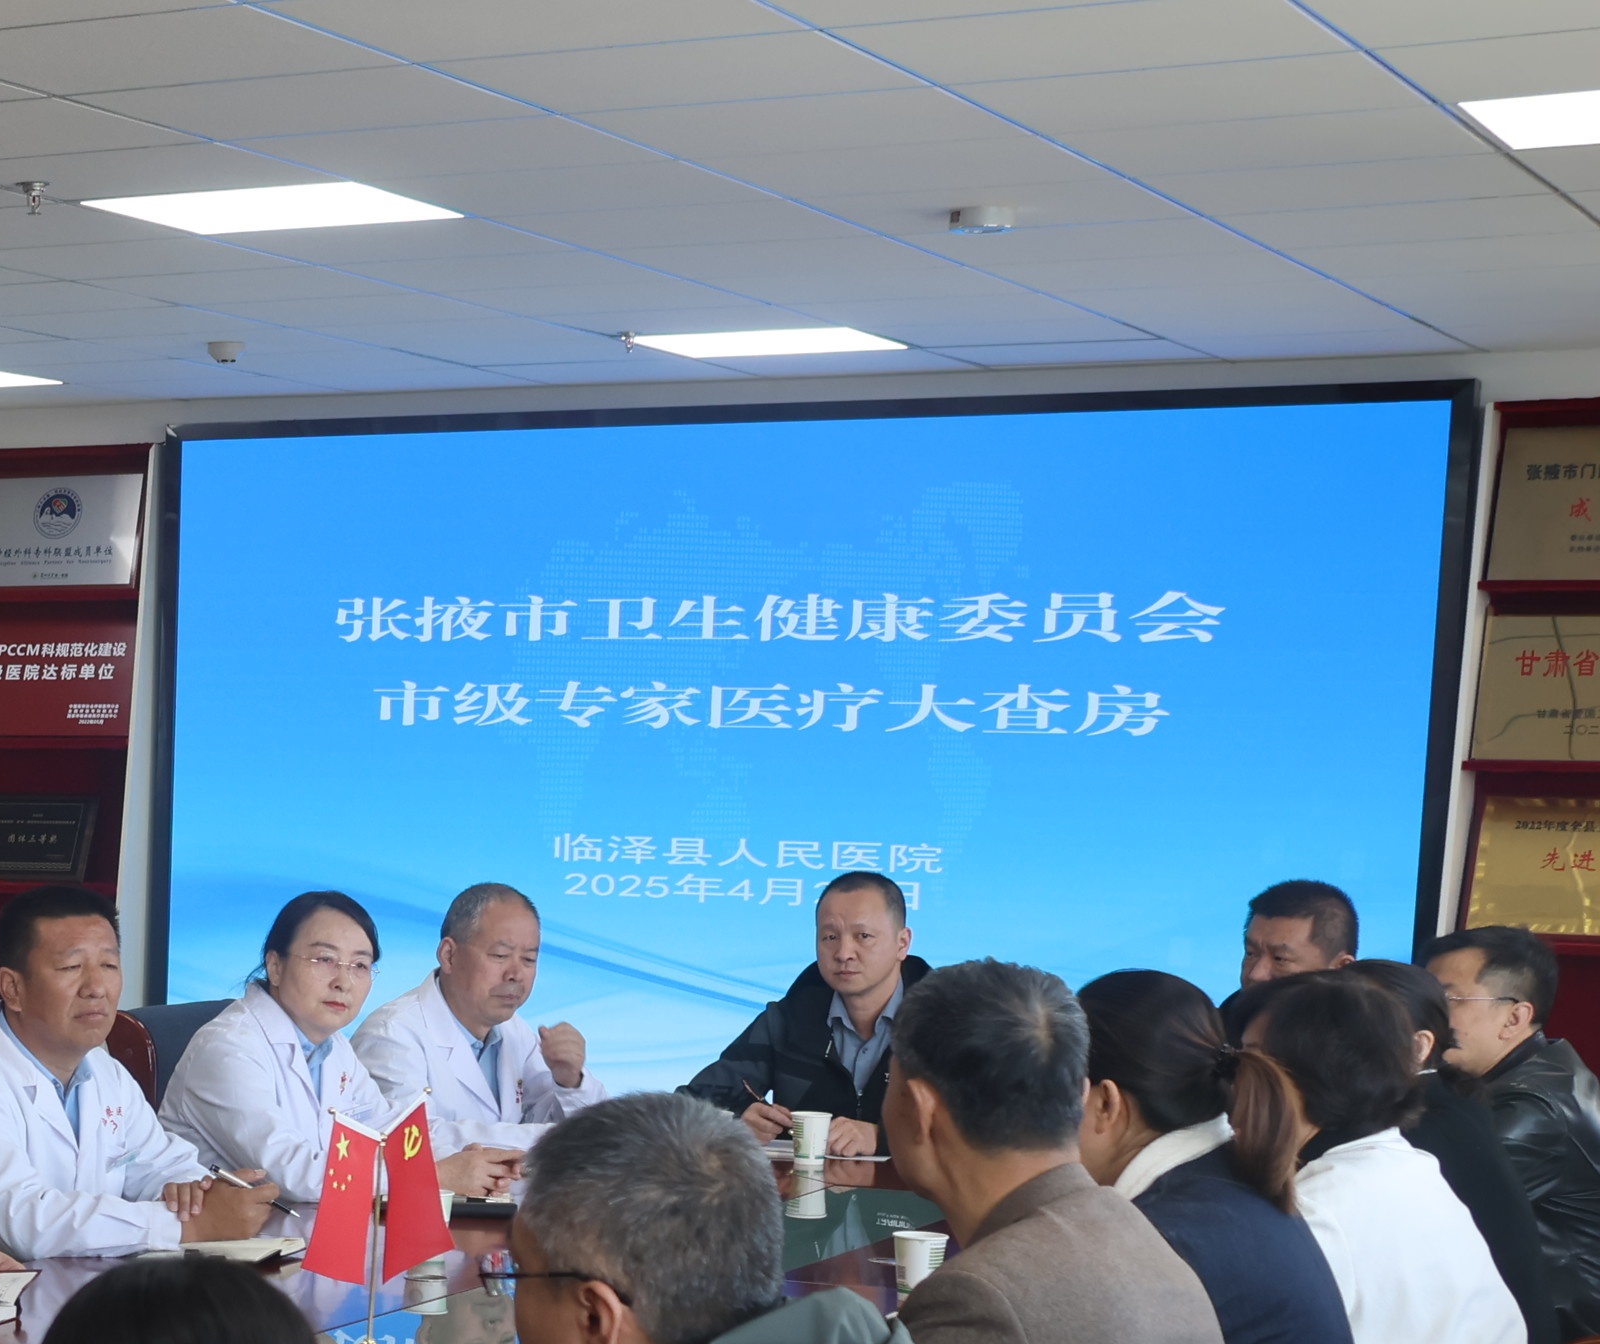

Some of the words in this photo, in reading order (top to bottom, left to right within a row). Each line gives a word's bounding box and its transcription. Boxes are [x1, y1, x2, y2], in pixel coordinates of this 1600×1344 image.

[1526, 463, 1600, 482] 张掖市门
[334, 586, 1226, 649] 张掖市卫生健康委员会
[1515, 648, 1600, 680] 甘肃省
[373, 678, 1173, 742] 市级专家医疗大查房
[1515, 818, 1600, 833] 2022年度全县
[552, 832, 944, 874] 临泽县人民医院
[1540, 847, 1595, 873] 先进
